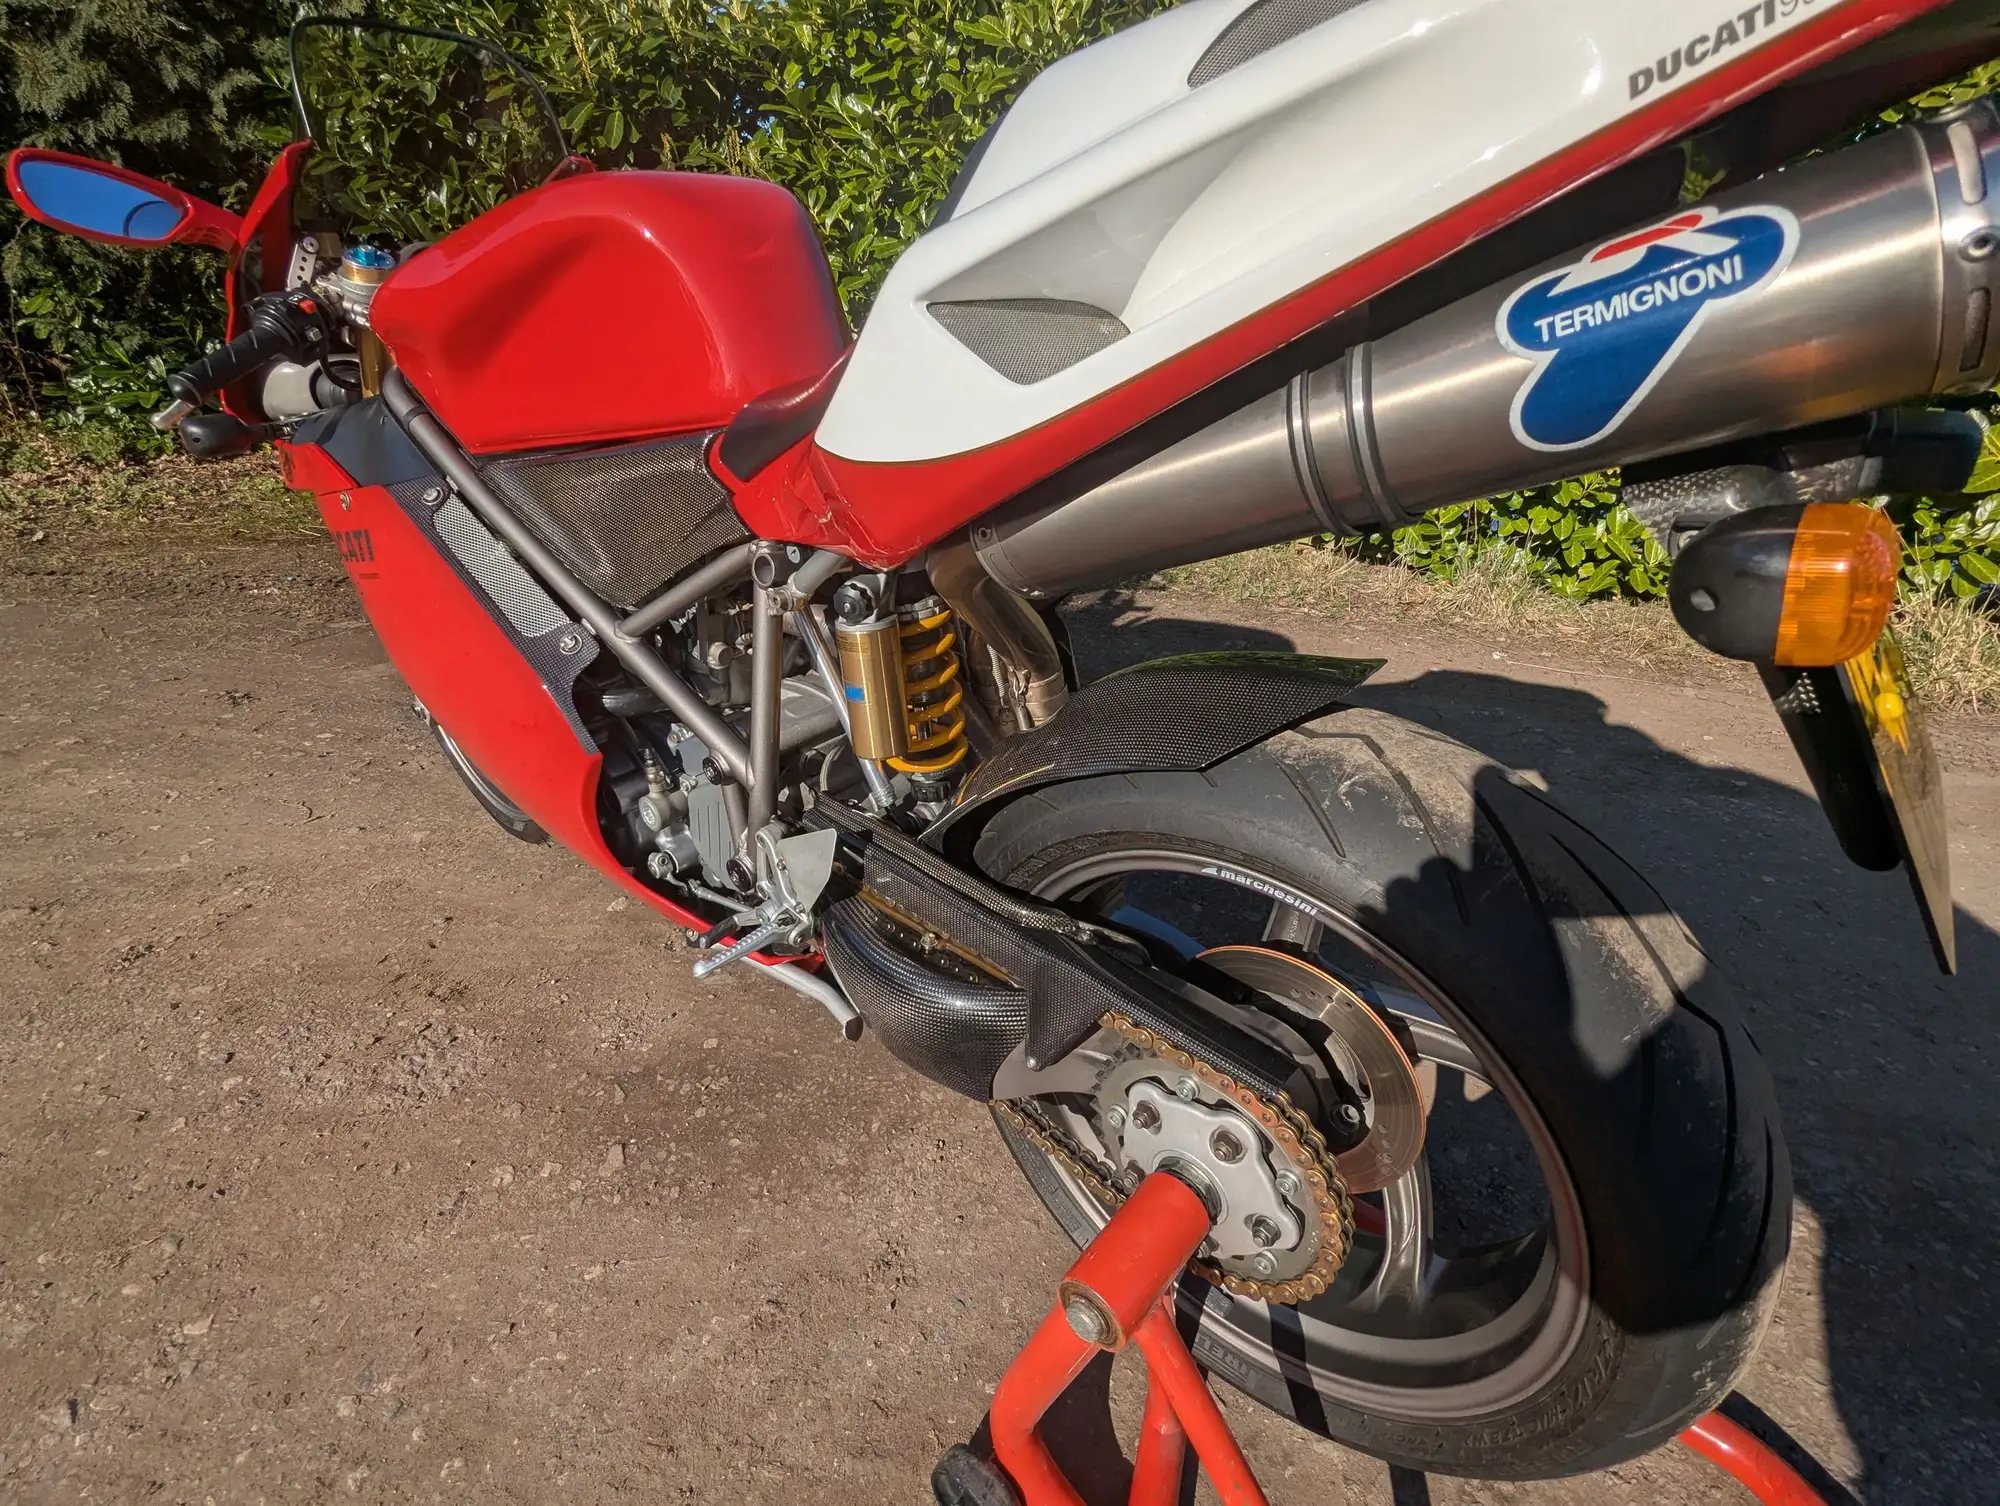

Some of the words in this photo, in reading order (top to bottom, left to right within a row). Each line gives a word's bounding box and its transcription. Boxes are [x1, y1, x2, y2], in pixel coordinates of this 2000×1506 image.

[1534, 256, 1743, 344] TERMIGNONI
[331, 529, 374, 562] CATI
[1220, 868, 1318, 916] marchesini
